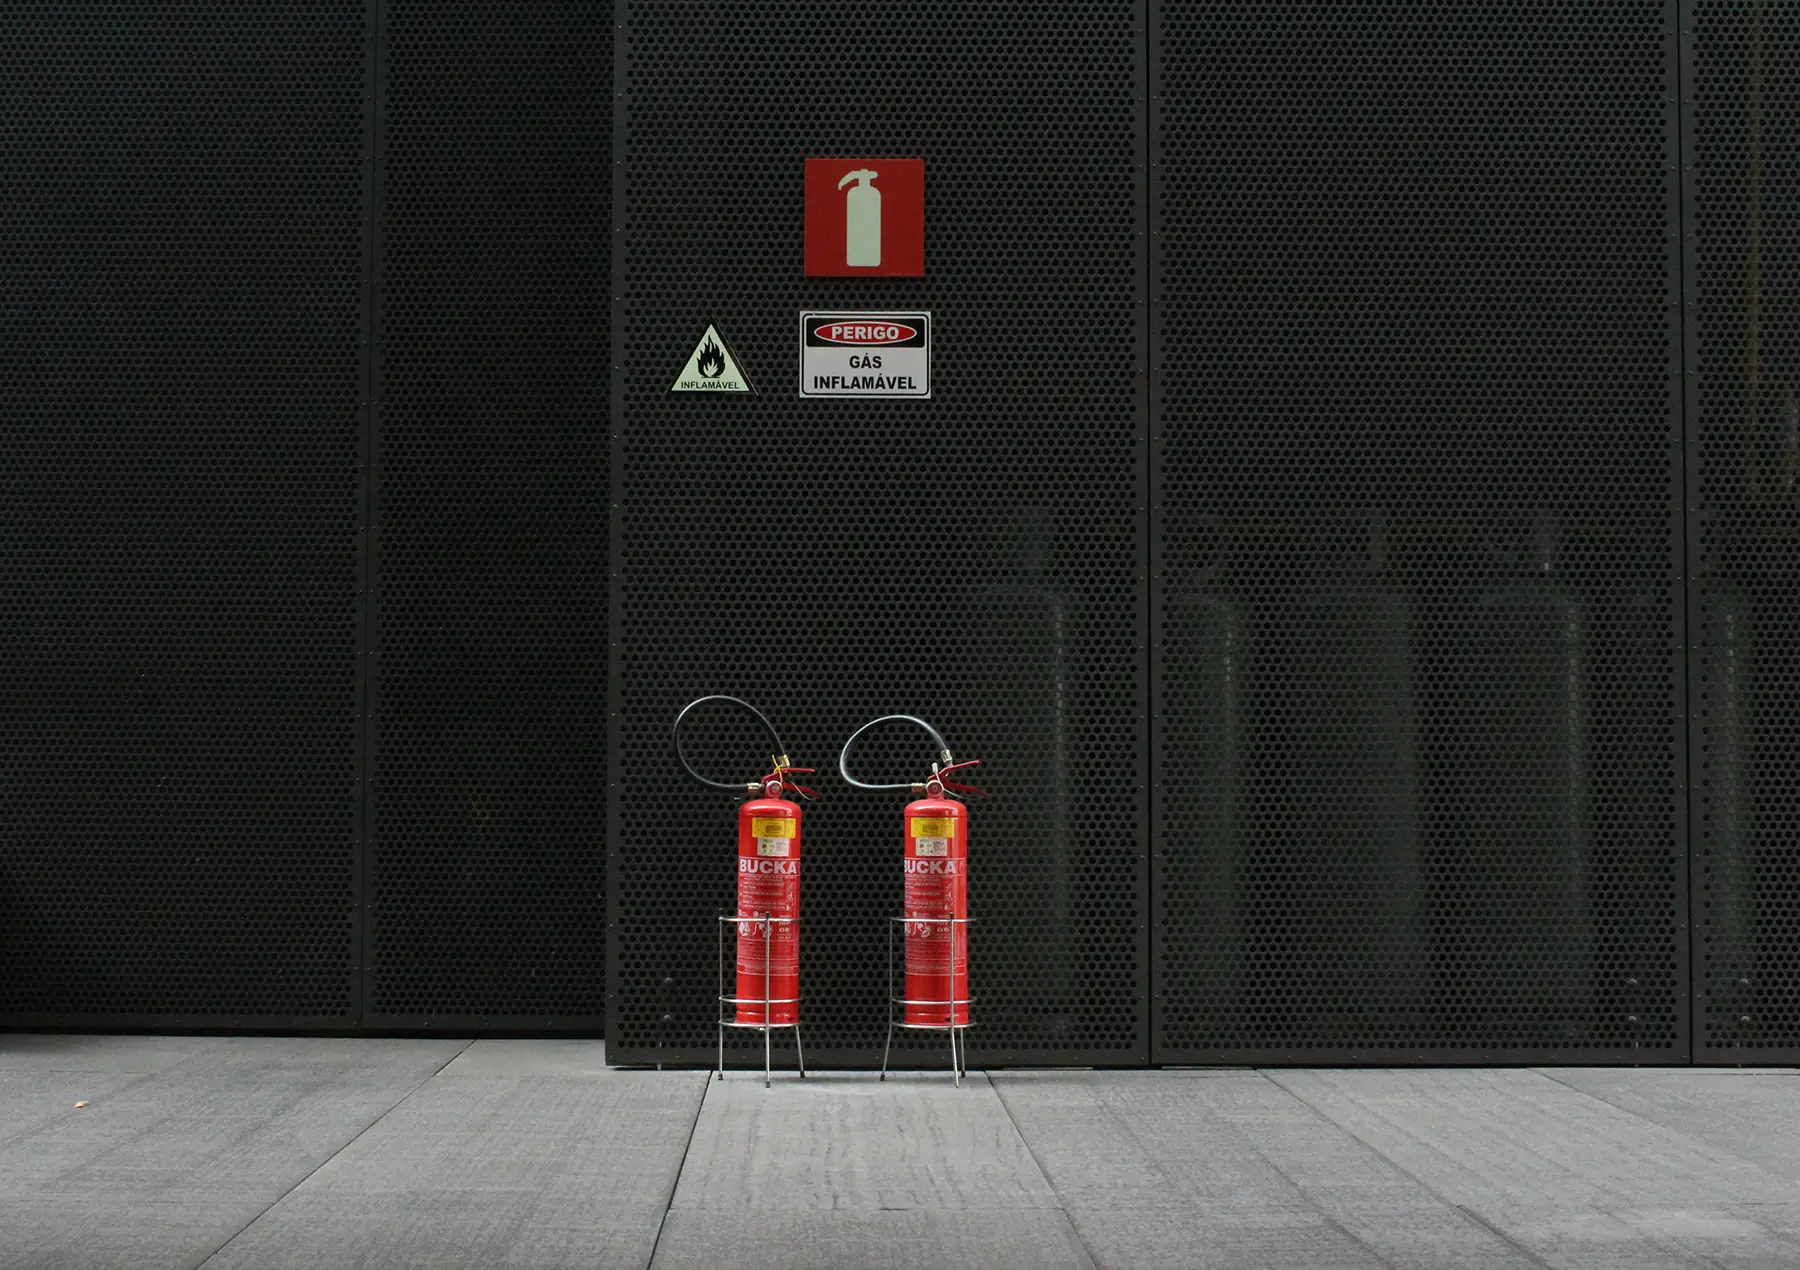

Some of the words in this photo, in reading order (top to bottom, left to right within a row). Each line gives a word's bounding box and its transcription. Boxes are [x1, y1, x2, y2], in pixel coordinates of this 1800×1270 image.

[831, 325, 900, 340] PERIGO
[849, 353, 882, 369] GÁS
[681, 380, 739, 389] INFLAMÁVEL
[813, 373, 917, 390] INFLAMÁVEL
[739, 859, 797, 874] BUCKA
